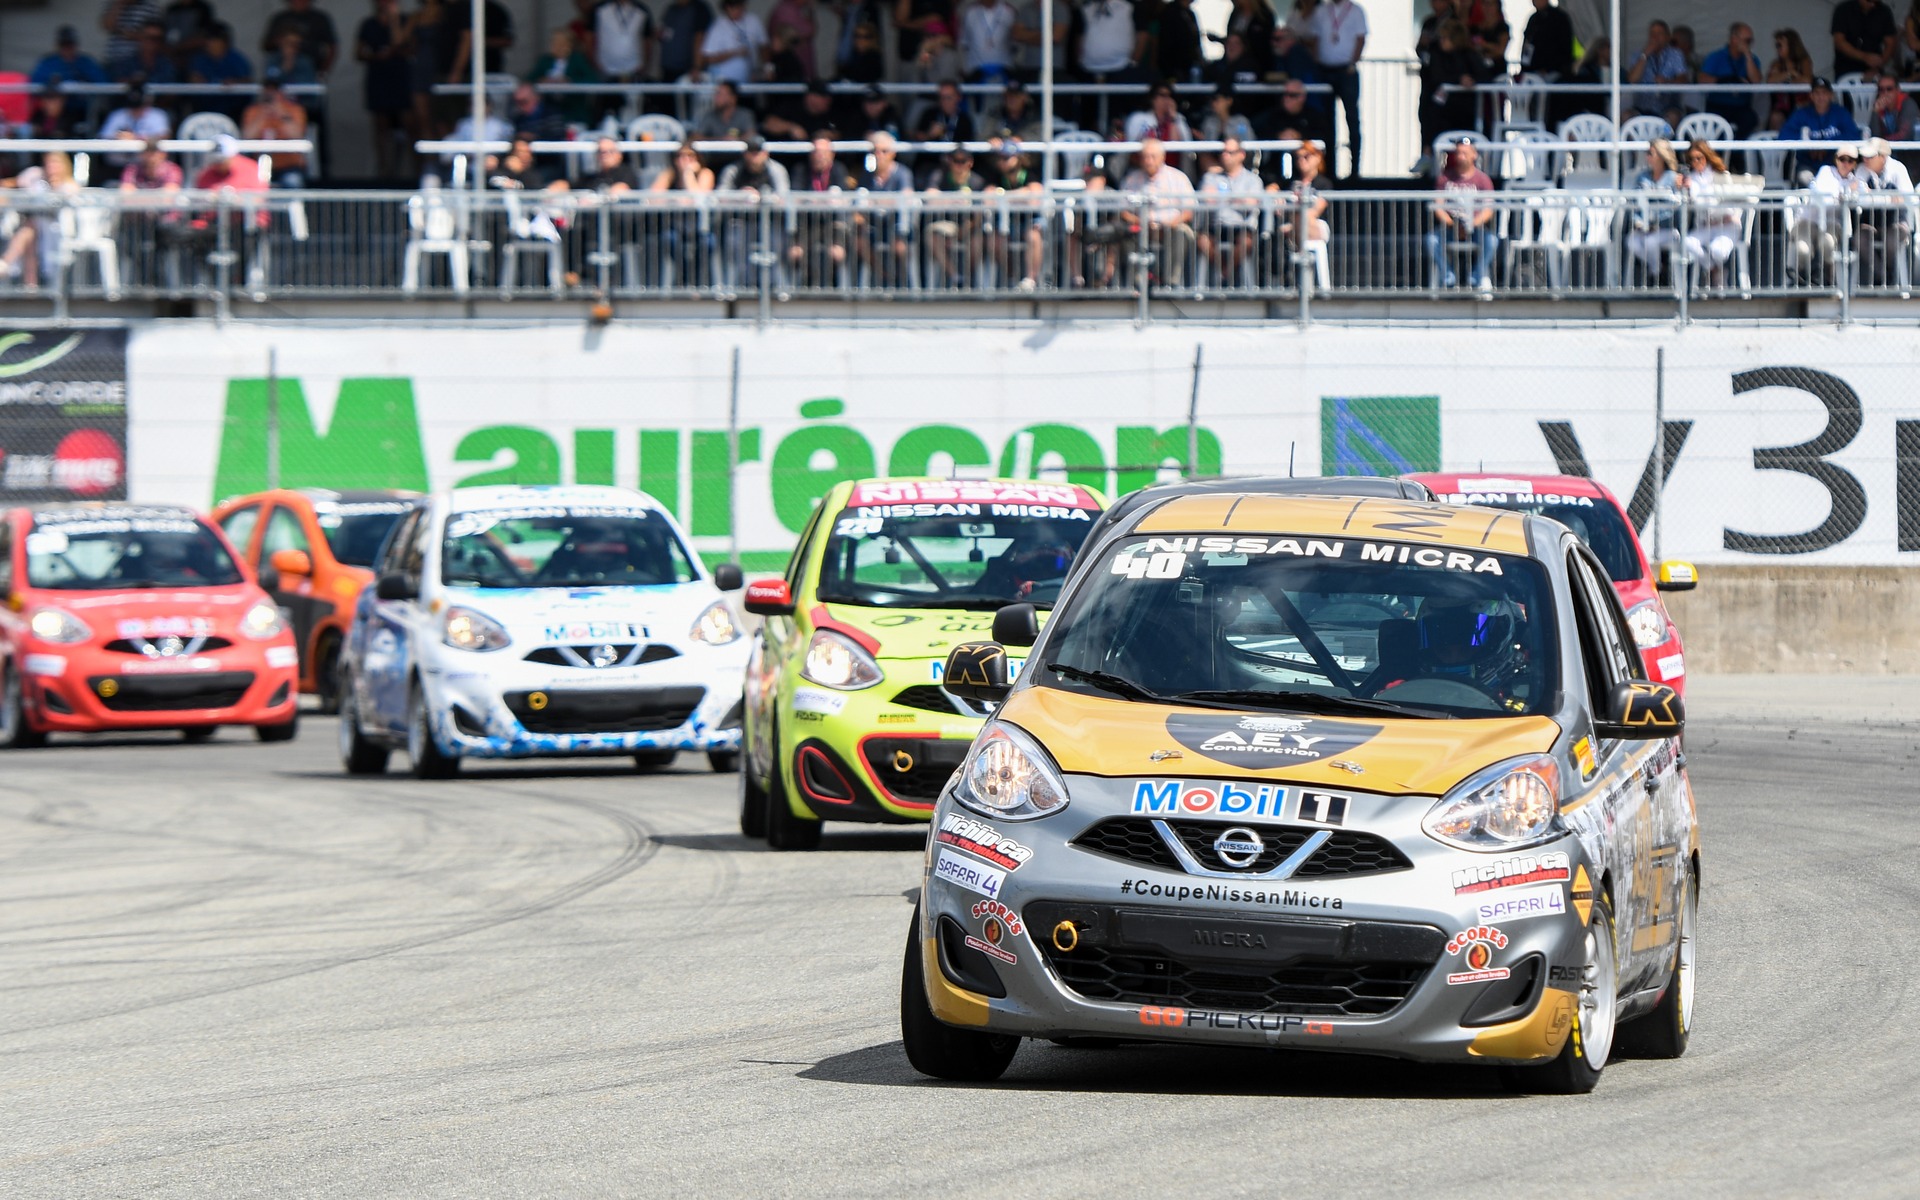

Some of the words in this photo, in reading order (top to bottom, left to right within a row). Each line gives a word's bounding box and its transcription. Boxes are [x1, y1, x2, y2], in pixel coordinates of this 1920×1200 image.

[213, 377, 1223, 536] Maurécon
[1538, 365, 1920, 555] v3
[860, 487, 1078, 505] NISSAN
[1516, 493, 1594, 507] MICRA
[857, 503, 981, 518] NISSAN
[991, 504, 1091, 522] MICRA
[1110, 552, 1188, 580] 40
[1146, 537, 1345, 559] NISSAN
[1360, 543, 1504, 576] MICRA
[749, 585, 785, 598] TOTAL
[544, 622, 621, 640] Mobil
[1199, 742, 1321, 758] Construction
[1203, 730, 1327, 749] AEY
[1132, 781, 1288, 818] Mobil
[941, 814, 1032, 863] Mchip.ca
[1218, 842, 1259, 852] NISSAN
[957, 838, 1019, 870] PERFORMANCE
[938, 858, 981, 886] SAFARI
[982, 873, 998, 896] 4
[1452, 853, 1569, 888] Mchip.ca
[1120, 879, 1344, 910] #CoupeNissanMicra
[1480, 897, 1545, 918] SAFARI
[1549, 892, 1563, 912] 4
[972, 901, 1023, 935] SCORES
[1191, 929, 1268, 950] MICRA
[1447, 926, 1508, 954] SCORES
[1549, 965, 1582, 981] FAST
